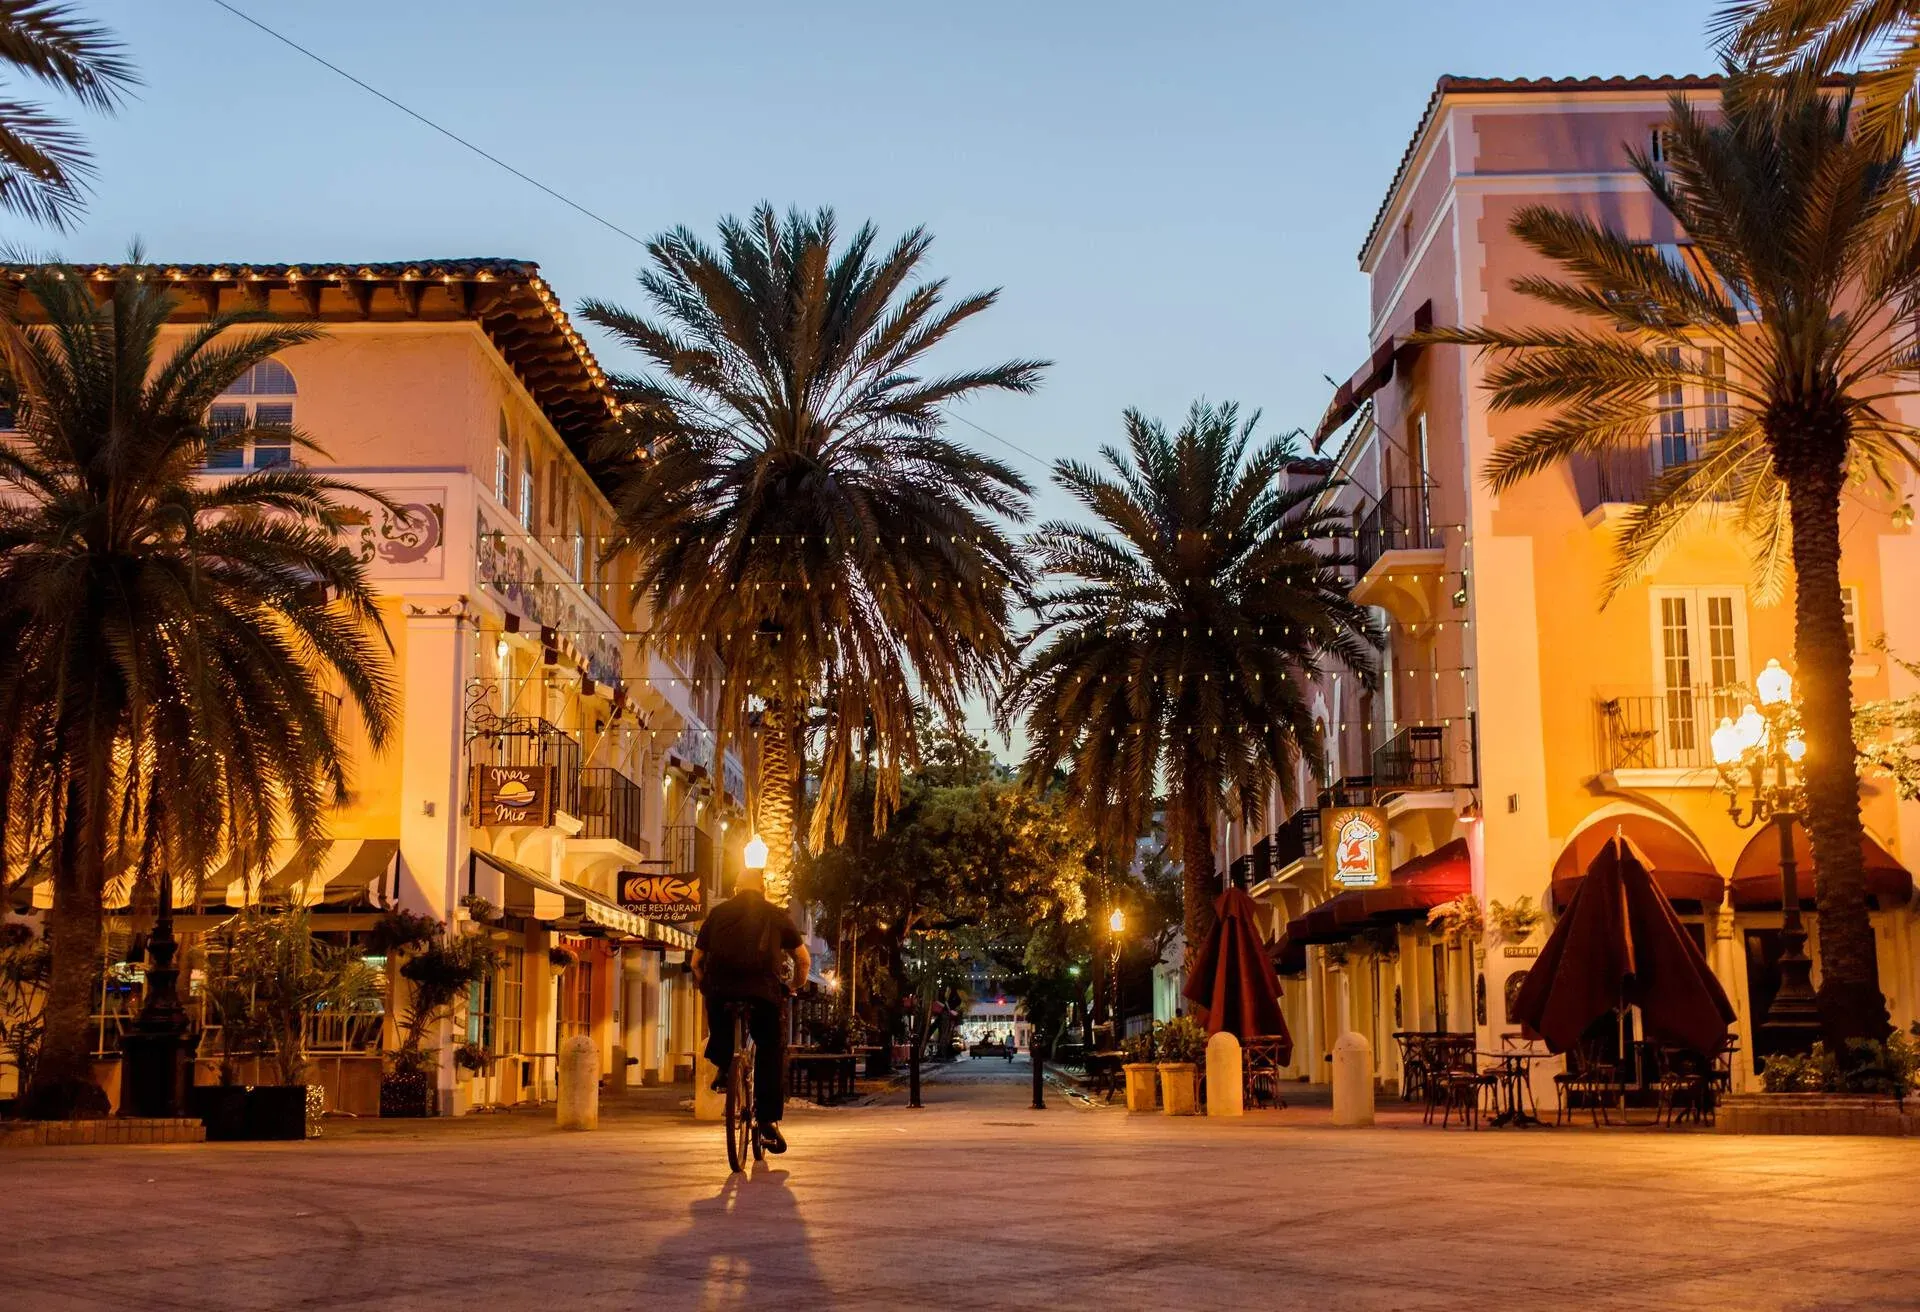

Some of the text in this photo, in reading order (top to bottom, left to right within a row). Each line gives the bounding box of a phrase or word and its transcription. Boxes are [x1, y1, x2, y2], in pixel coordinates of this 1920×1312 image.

[491, 768, 530, 786] Mare
[495, 804, 527, 822] Mio
[649, 904, 702, 912] RESTAURANT
[663, 912, 670, 920] &
[671, 912, 687, 920] Grill
